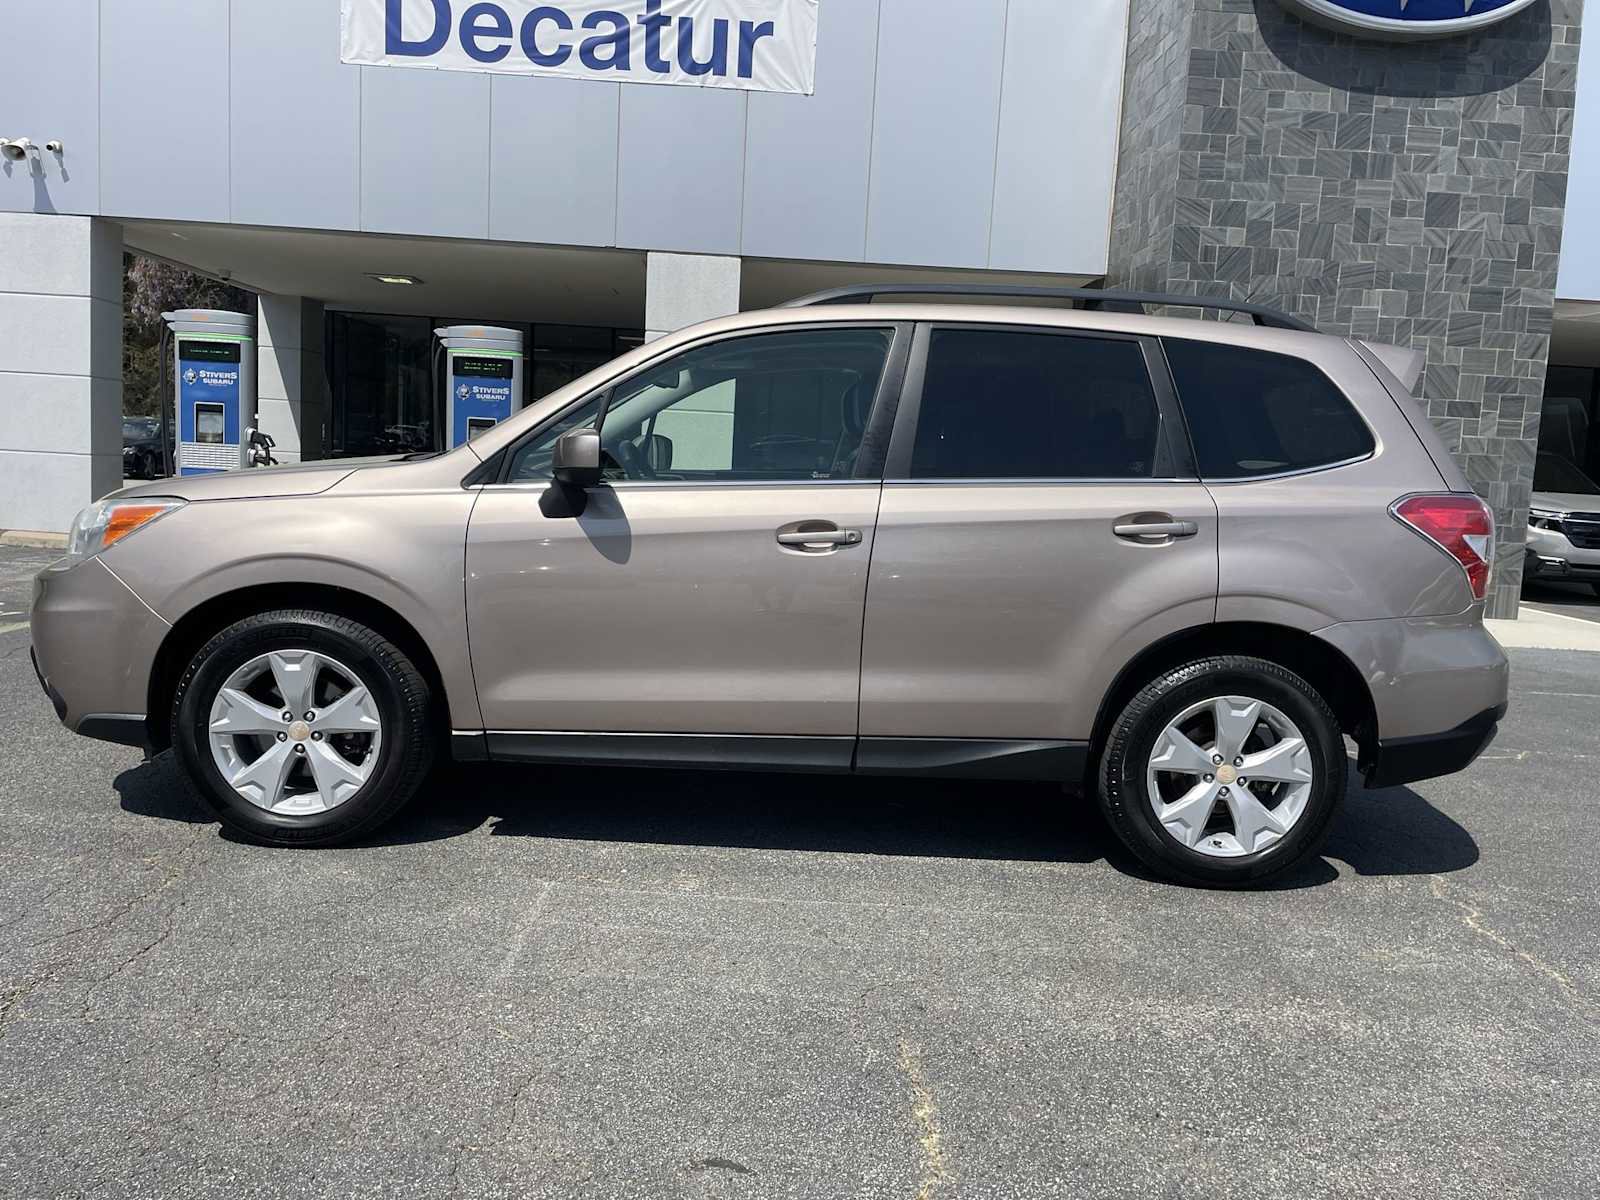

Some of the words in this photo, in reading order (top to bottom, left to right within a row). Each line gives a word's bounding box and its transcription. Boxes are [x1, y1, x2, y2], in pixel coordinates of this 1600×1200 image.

[385, 0, 774, 78] Decatur
[199, 370, 237, 380] STIVERS
[203, 378, 234, 386] SUBARU
[472, 386, 510, 395] STIVERS
